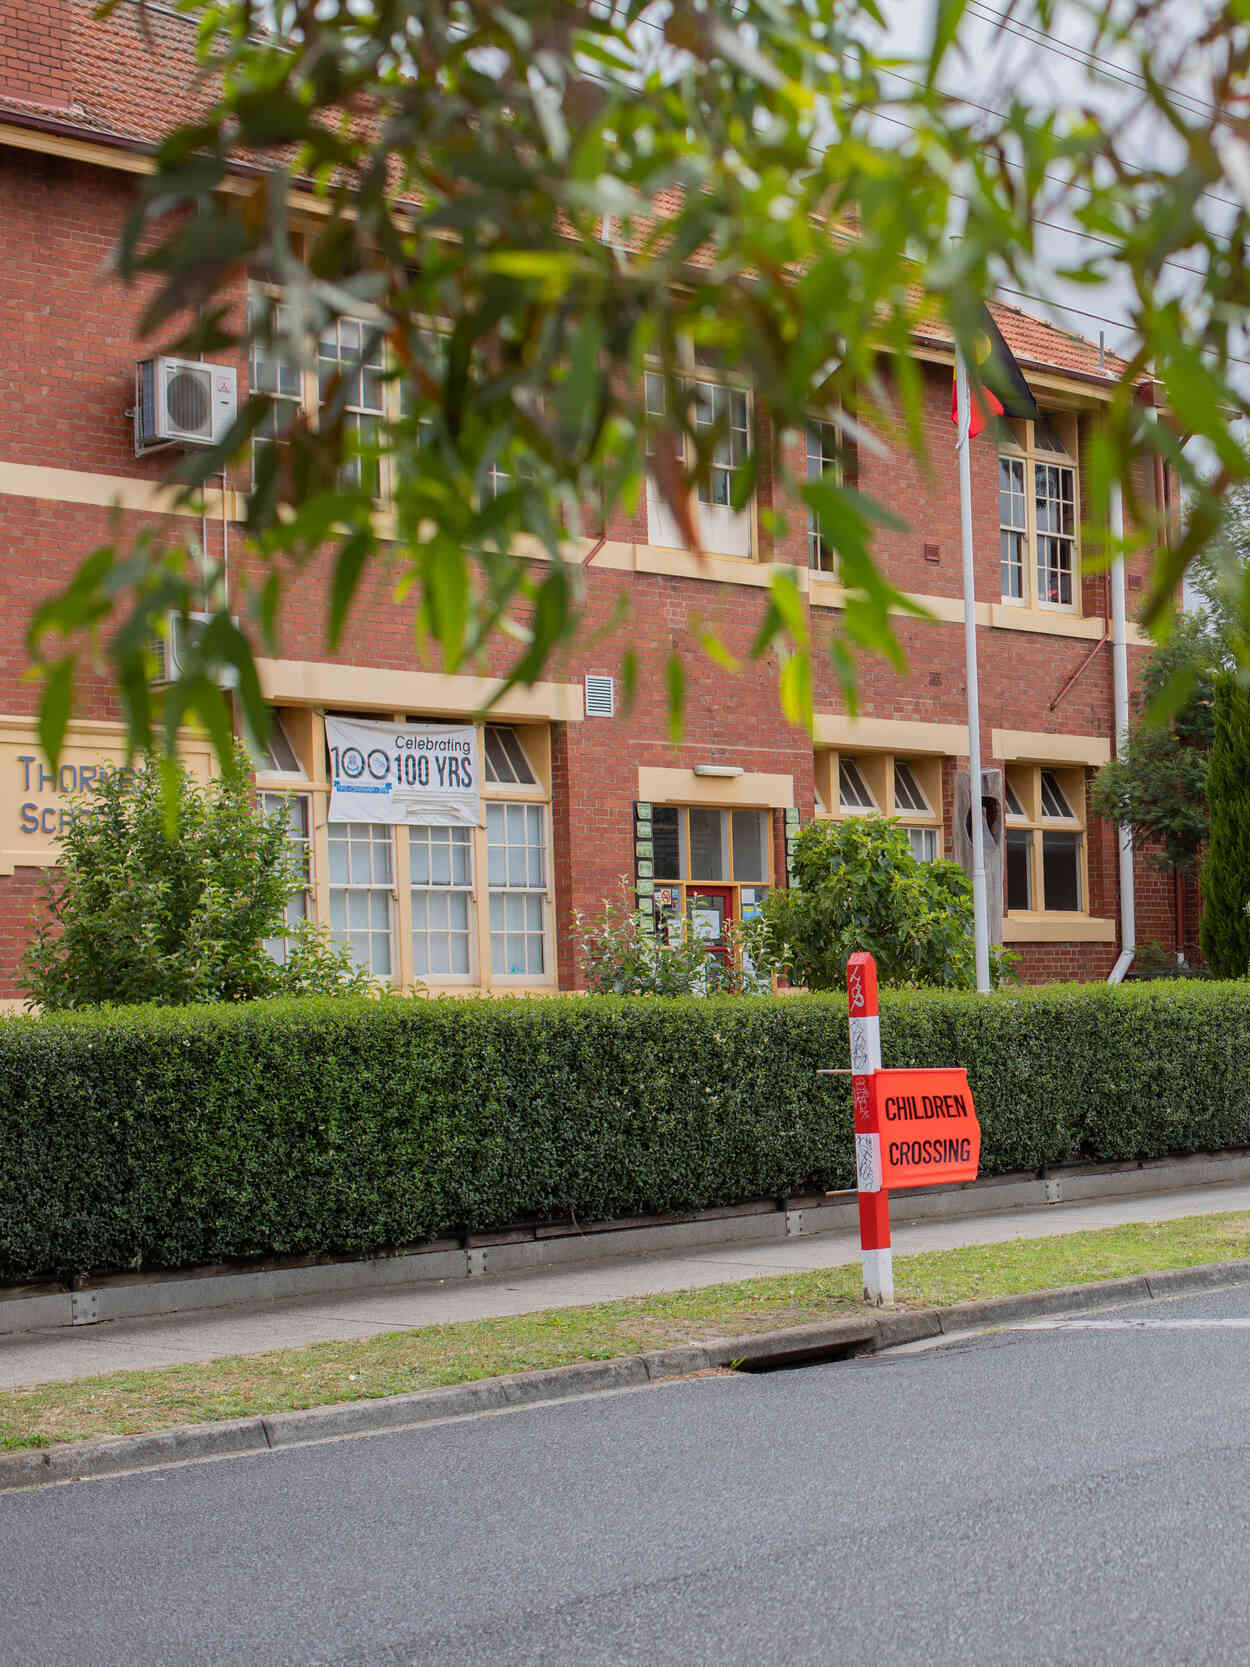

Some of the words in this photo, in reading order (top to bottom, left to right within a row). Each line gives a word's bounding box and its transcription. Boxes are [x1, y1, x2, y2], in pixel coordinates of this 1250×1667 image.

[395, 736, 471, 755] Celebrating
[394, 754, 429, 785] 100
[435, 756, 472, 788] YRS
[884, 1094, 968, 1121] CHILDREN
[888, 1138, 971, 1167] CROSSING
